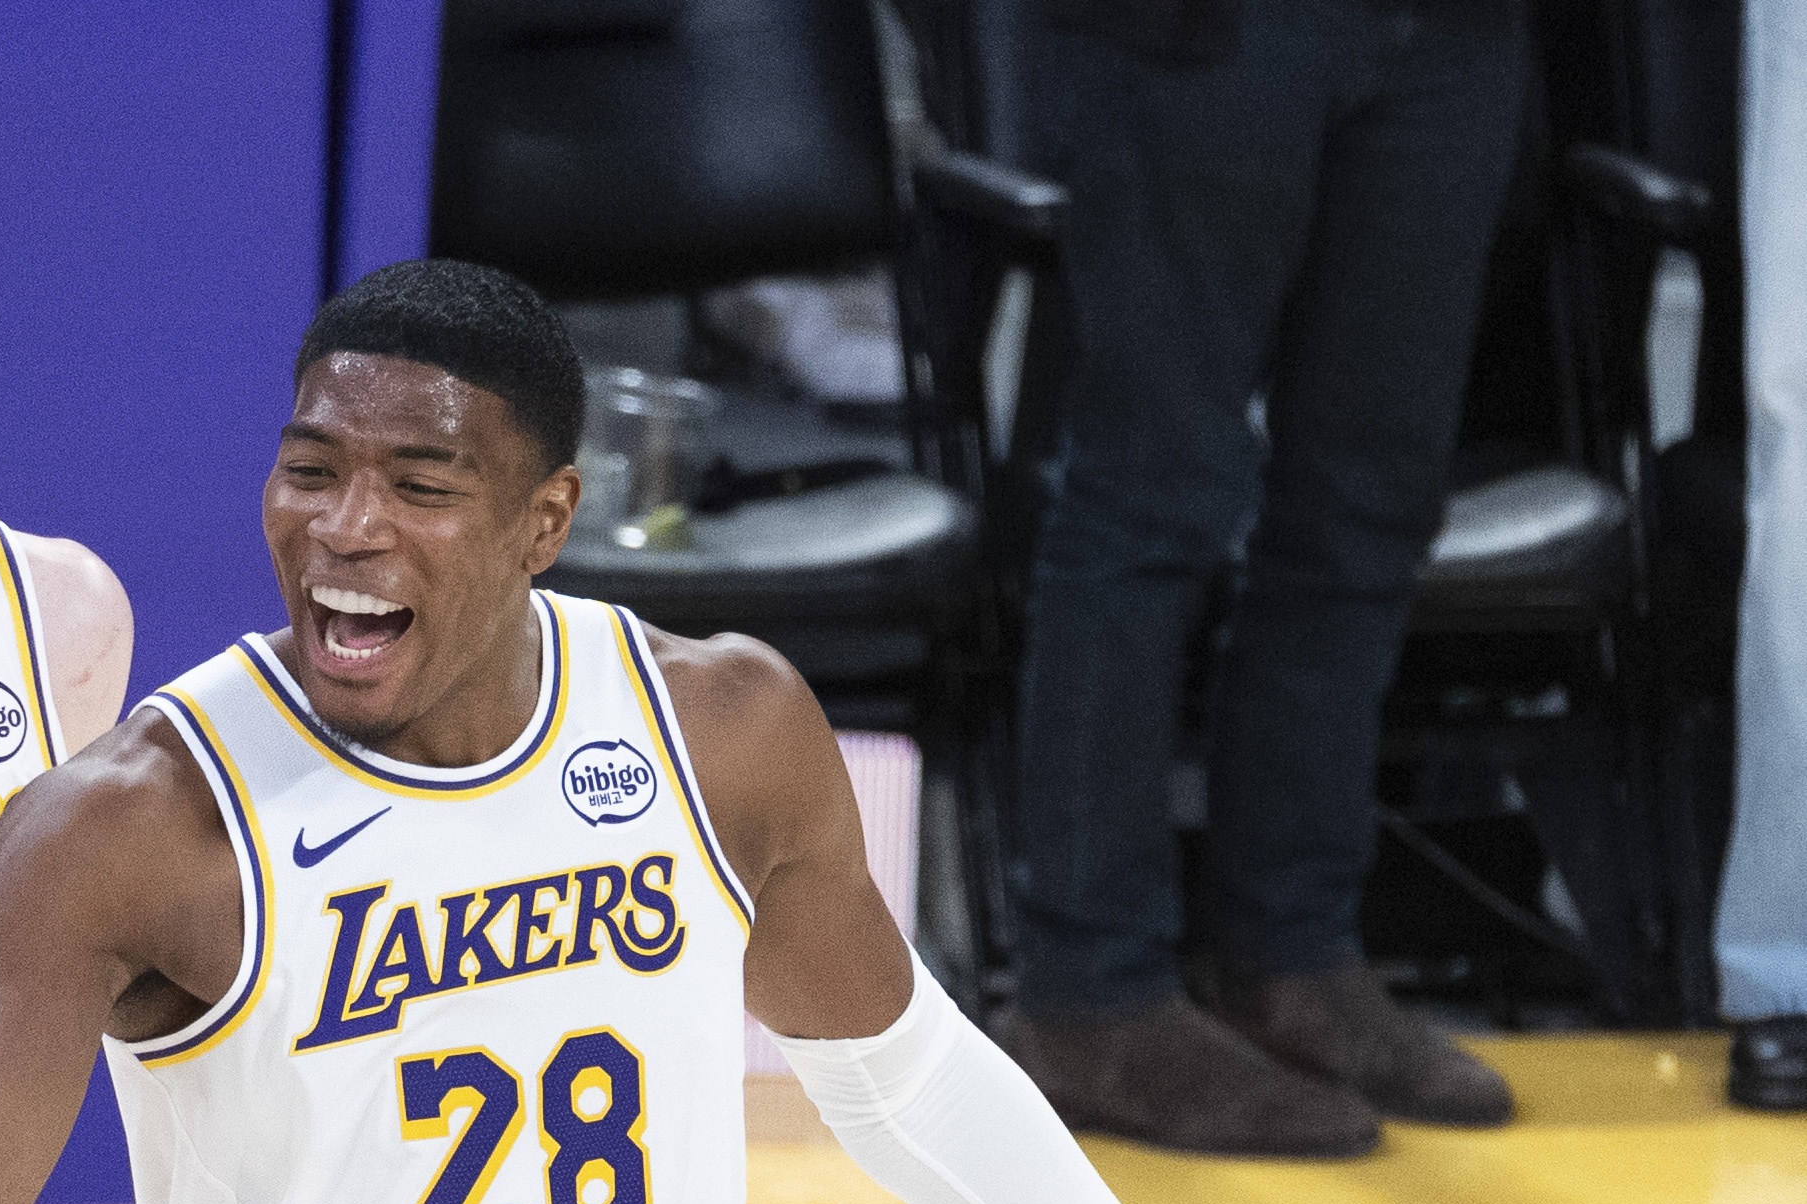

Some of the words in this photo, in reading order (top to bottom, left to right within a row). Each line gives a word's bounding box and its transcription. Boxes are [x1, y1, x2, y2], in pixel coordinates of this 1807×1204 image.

[569, 762, 649, 796] bibigo
[588, 791, 623, 807] 비비고
[288, 851, 688, 1057] LAKERS
